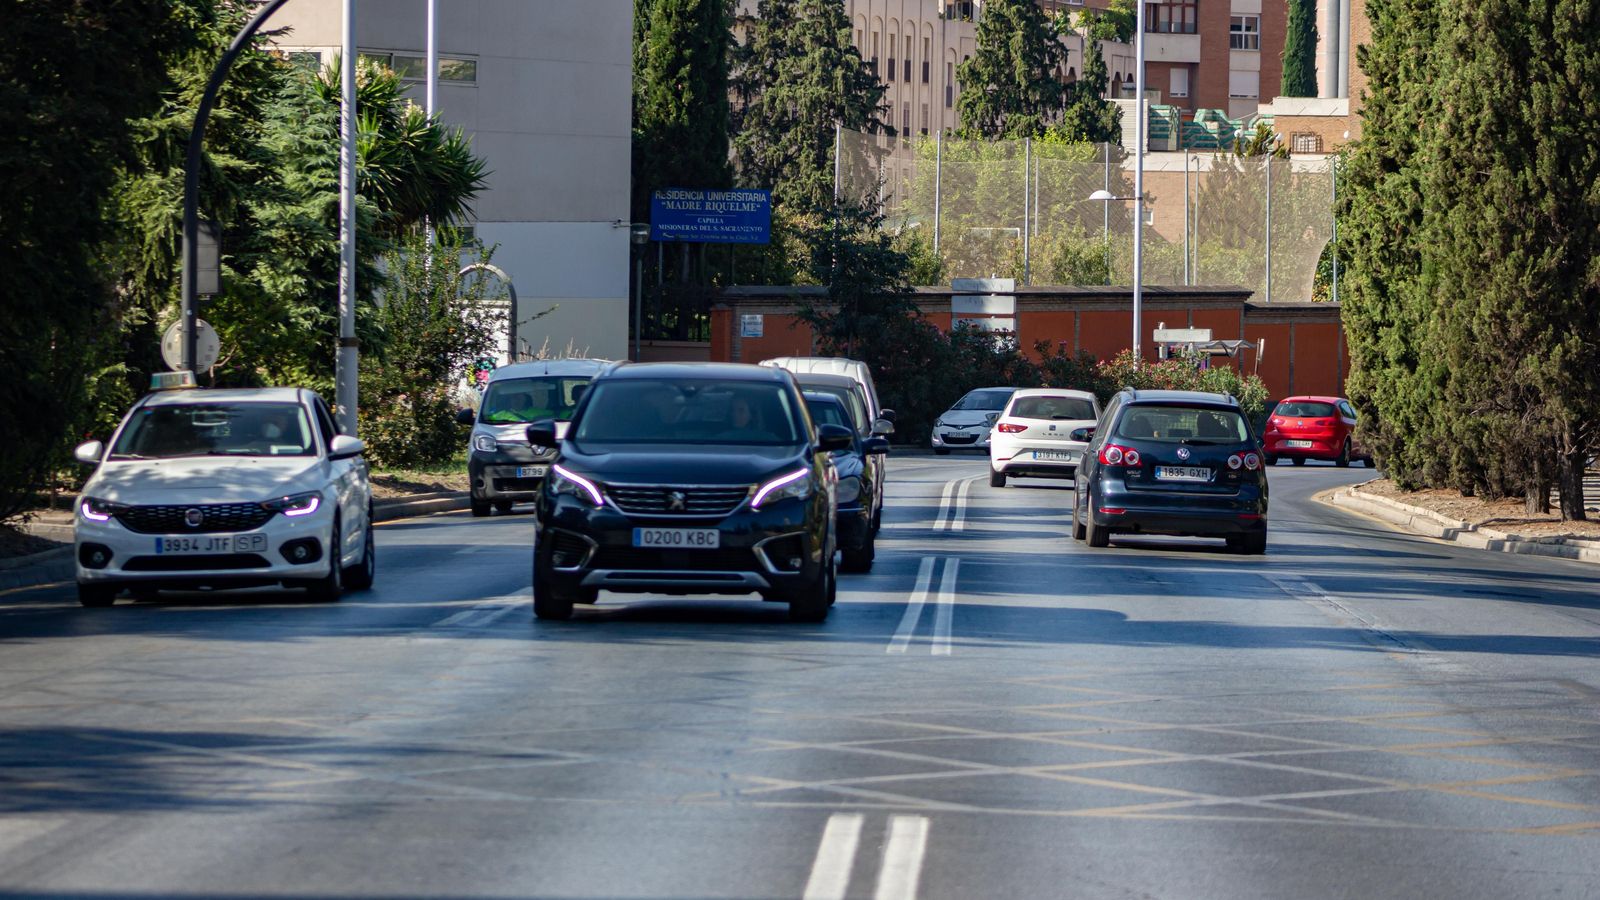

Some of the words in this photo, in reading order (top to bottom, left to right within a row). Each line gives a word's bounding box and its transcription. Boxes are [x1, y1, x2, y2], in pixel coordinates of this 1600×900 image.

[655, 190, 705, 201] RESIDENCIA
[707, 191, 767, 202] UNIVERSITARIA
[658, 223, 698, 231] MISIONERAS
[1164, 467, 1185, 477] 1835
[1189, 468, 1208, 478] GXH
[238, 535, 263, 550] SP
[644, 530, 682, 545] 0200
[686, 531, 715, 545] KBC
[164, 538, 199, 552] 3934
[204, 537, 230, 551] JTF
